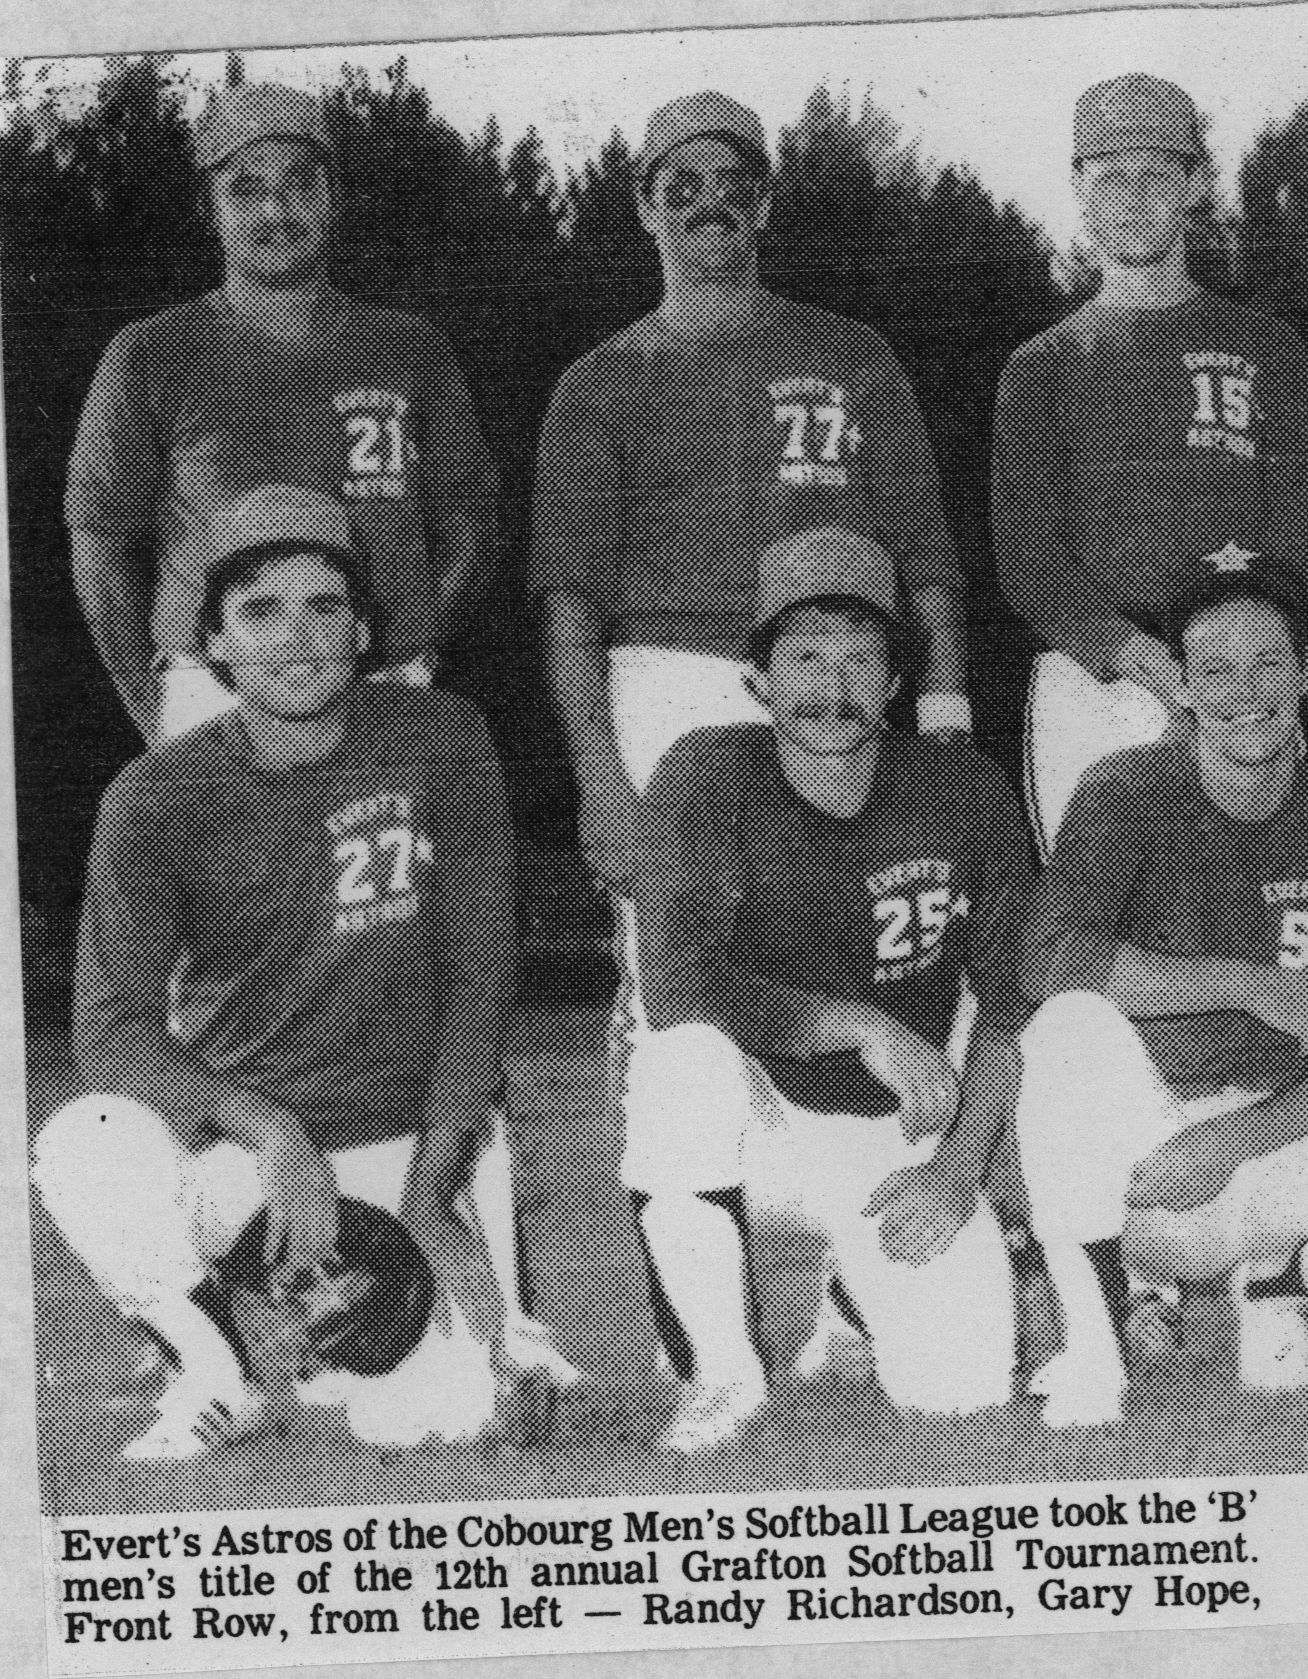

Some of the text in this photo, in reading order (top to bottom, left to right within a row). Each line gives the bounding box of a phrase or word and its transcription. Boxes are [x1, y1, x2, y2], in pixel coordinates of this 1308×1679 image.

[774, 404, 845, 460] 77
[1191, 371, 1252, 431] 15
[345, 417, 403, 473] 21
[335, 827, 413, 903] 27
[866, 857, 953, 895] EVERT'S
[873, 888, 951, 960] 25
[211, 1524, 333, 1557] Astros
[343, 1518, 379, 1552] of
[387, 1517, 448, 1551] the
[456, 1513, 613, 1552] Cobourg
[745, 1502, 890, 1540] Softball
[899, 1502, 1039, 1539] League
[1049, 1493, 1129, 1528] took
[1138, 1491, 1197, 1525] the
[199, 1563, 275, 1598] title
[296, 1561, 332, 1595] of
[353, 1559, 413, 1593] the
[435, 1555, 509, 1591] 12th
[530, 1550, 659, 1588] annual
[681, 1547, 827, 1583] Grafton
[848, 1539, 994, 1578] Softball
[1015, 1532, 1260, 1570] Tournament.
[64, 1609, 172, 1644] Front
[192, 1606, 289, 1643] Row,
[309, 1602, 400, 1635] from
[421, 1598, 480, 1632] the
[501, 1595, 563, 1629] left
[642, 1589, 766, 1630] Randy
[787, 1582, 1014, 1621] Richardson,
[1037, 1578, 1133, 1617] Gary
[1154, 1574, 1261, 1613] Hope,
